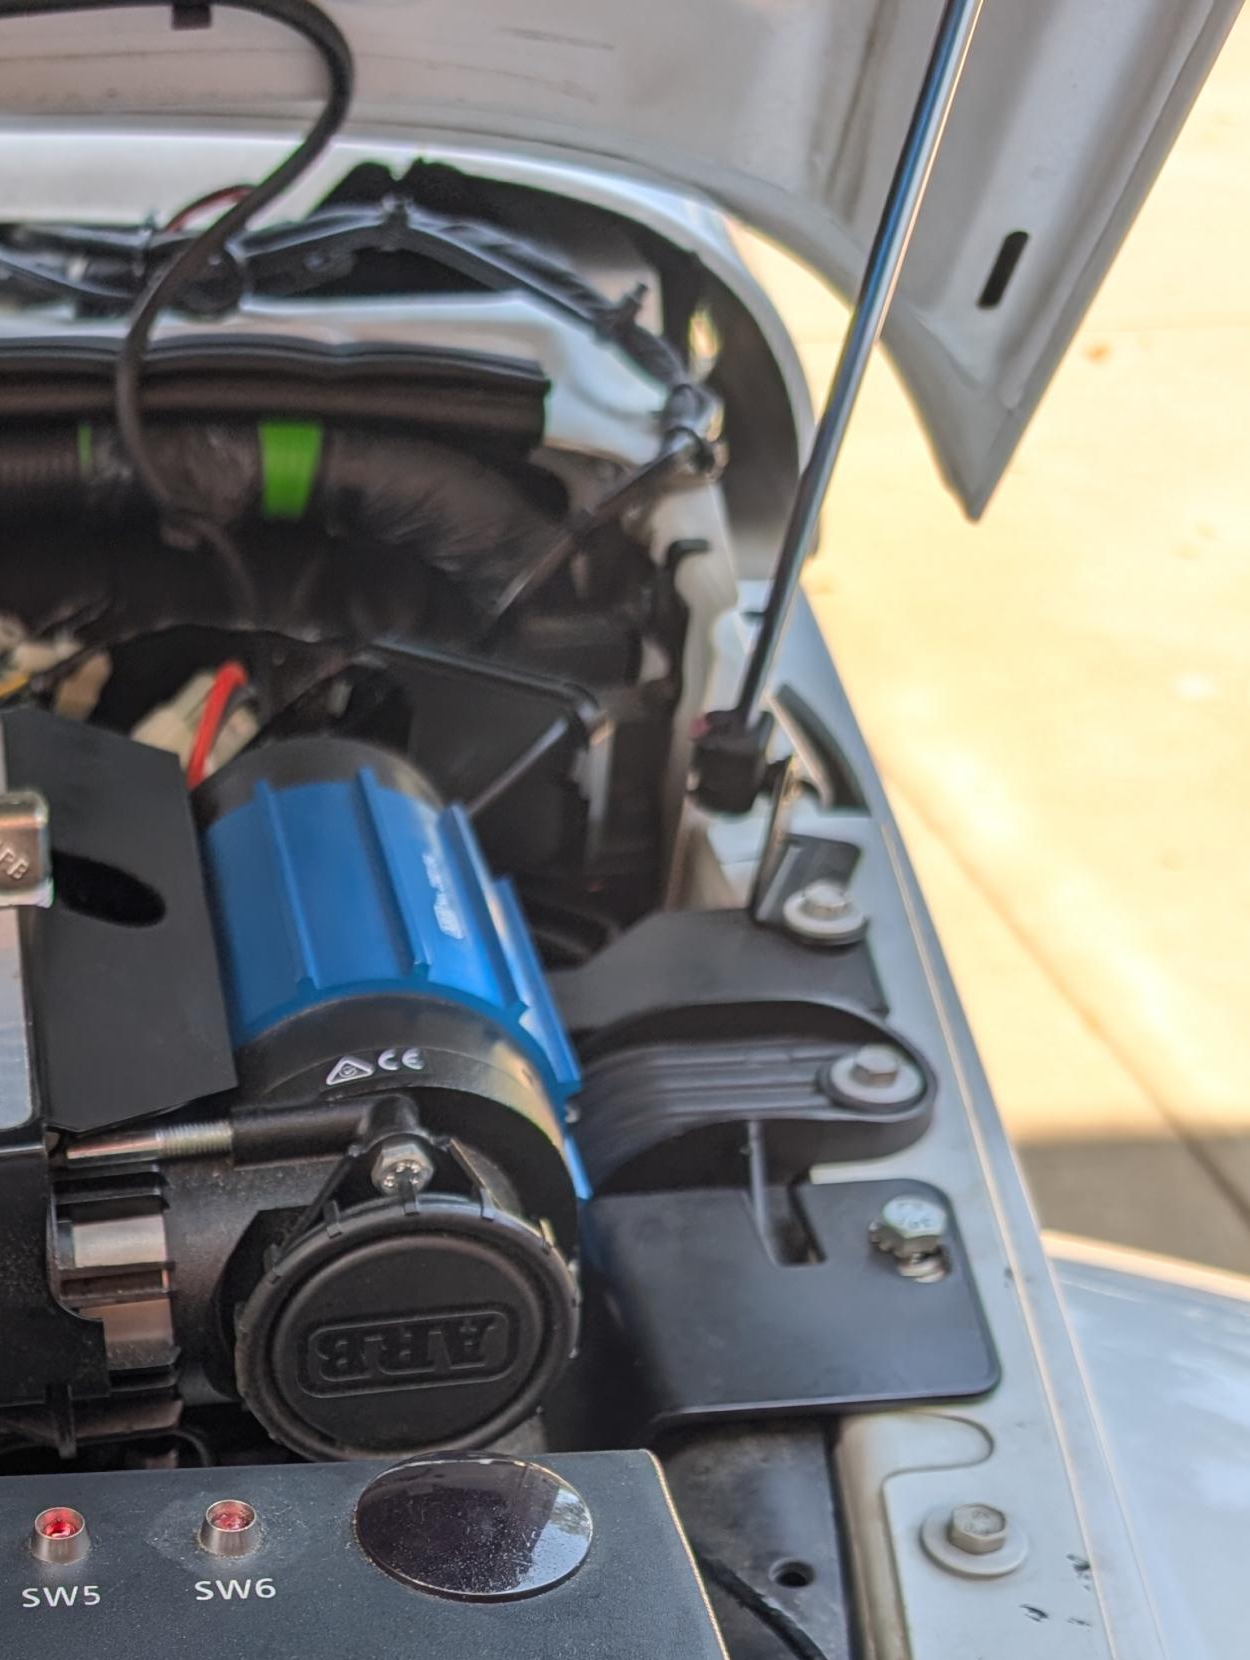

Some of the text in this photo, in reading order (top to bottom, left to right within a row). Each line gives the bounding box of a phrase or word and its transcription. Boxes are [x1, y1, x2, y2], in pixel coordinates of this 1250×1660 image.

[315, 1319, 496, 1383] ARB
[21, 1585, 102, 1608] SW5
[194, 1577, 277, 1601] SW6
